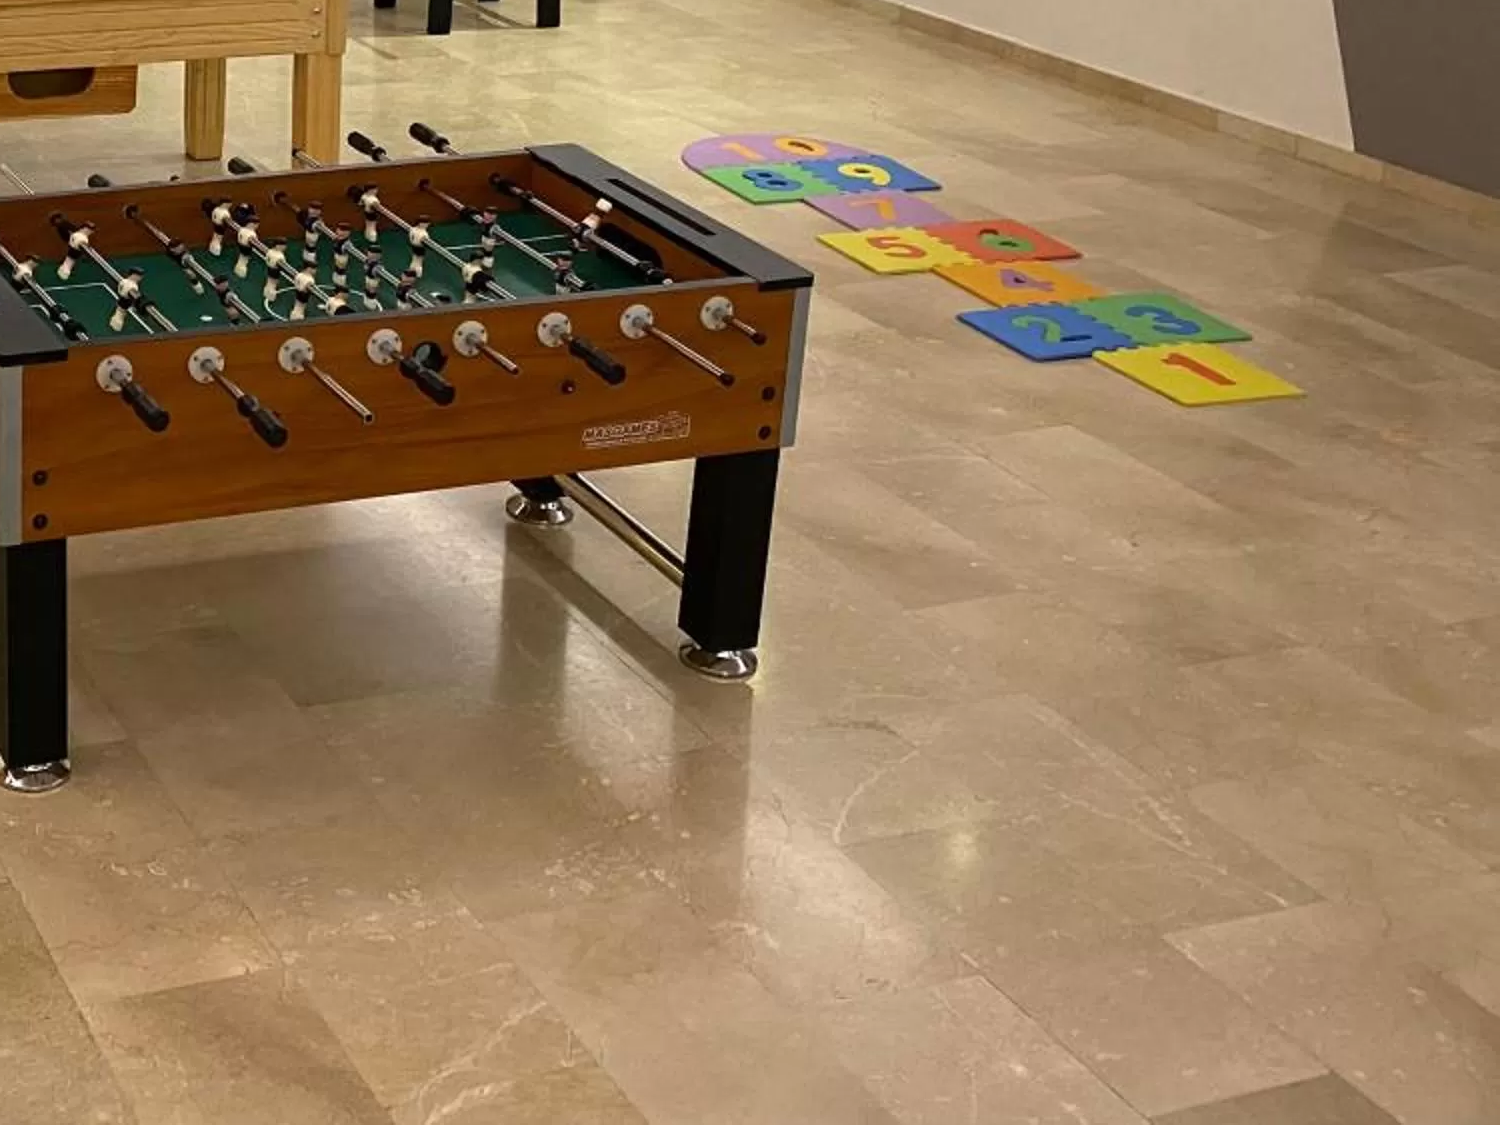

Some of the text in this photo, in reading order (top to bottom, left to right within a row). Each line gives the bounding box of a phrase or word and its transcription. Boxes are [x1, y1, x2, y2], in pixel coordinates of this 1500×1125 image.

[720, 136, 830, 162] 10
[741, 162, 891, 192] 8 9
[848, 197, 897, 221] 7
[866, 228, 1037, 259] 5 6
[999, 268, 1056, 292] 4
[1011, 305, 1202, 344] 2 3
[1161, 352, 1237, 386] 1
